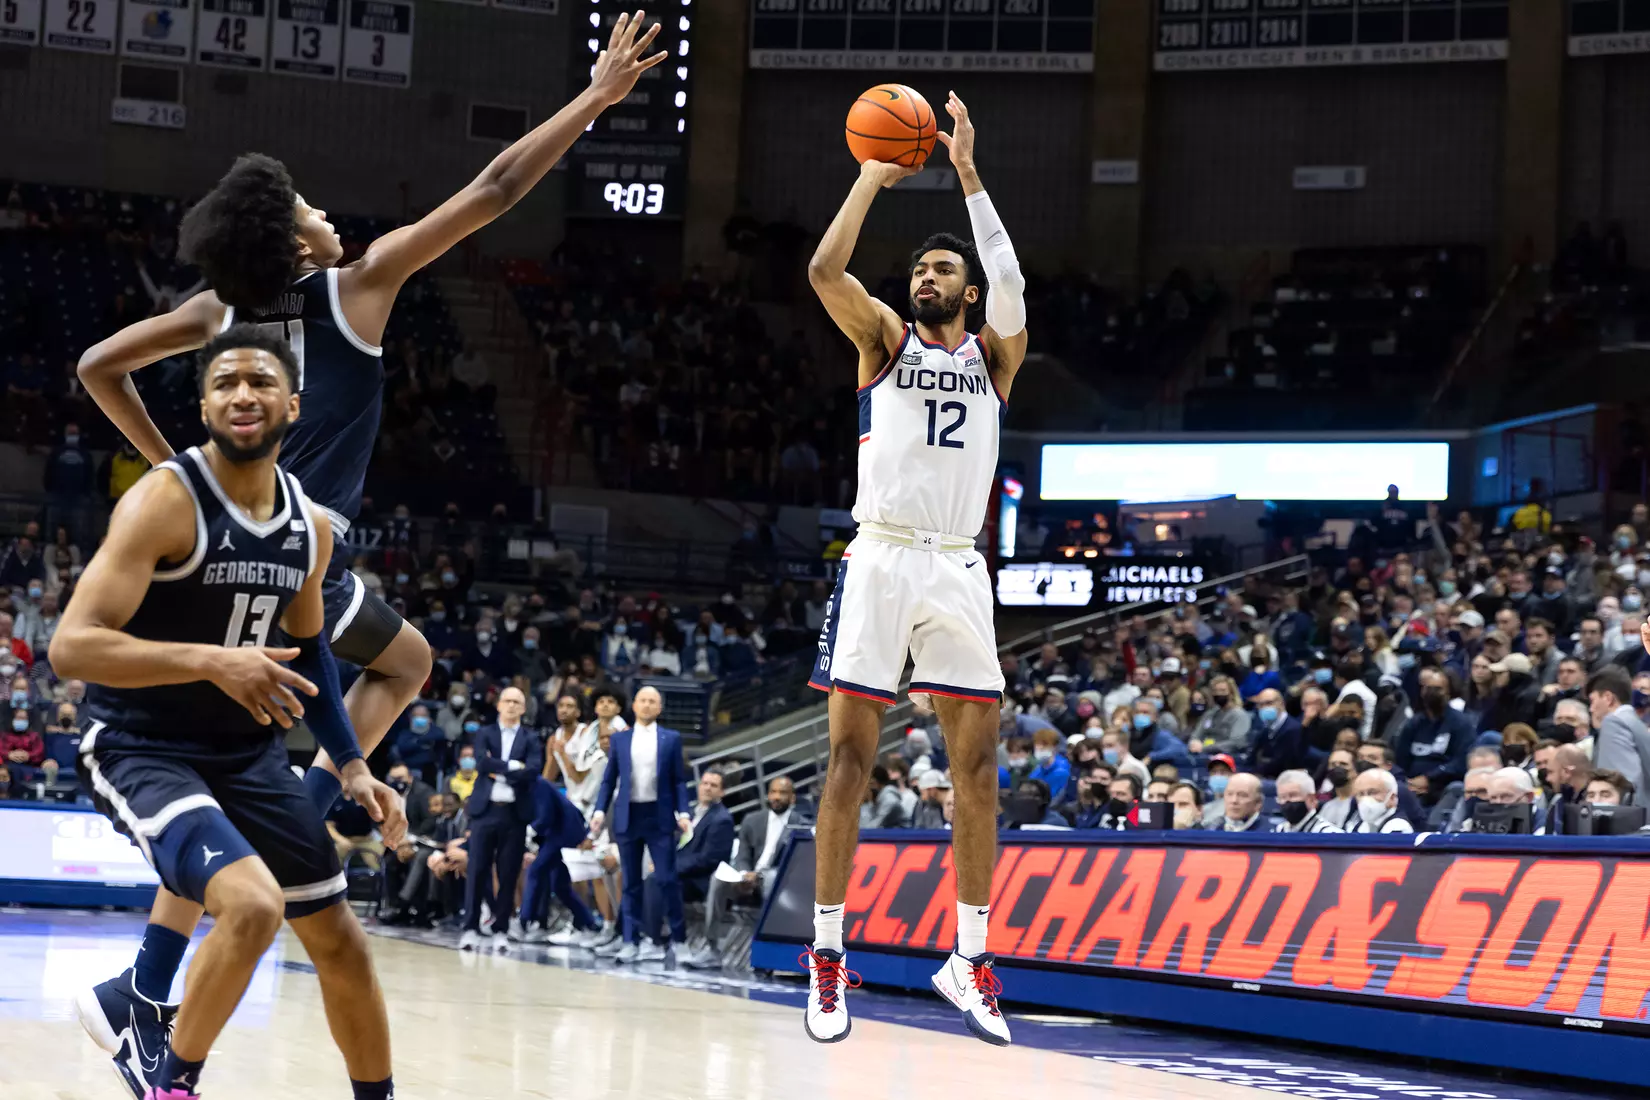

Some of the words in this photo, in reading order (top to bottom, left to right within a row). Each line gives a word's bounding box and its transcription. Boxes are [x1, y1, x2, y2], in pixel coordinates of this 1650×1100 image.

[67, 0, 96, 32] 22
[215, 17, 247, 52] 42
[292, 25, 322, 59] 13
[371, 34, 386, 67] 3
[758, 53, 887, 67] CONNECTICUT
[147, 105, 184, 125] 216
[604, 182, 664, 215] 9:03
[896, 368, 987, 395] UCONN
[925, 399, 968, 449] 12
[203, 561, 305, 592] GEORGETOWN
[223, 593, 279, 648] 13
[1291, 853, 1412, 991] &
[1192, 1056, 1525, 1100] MICHAE
